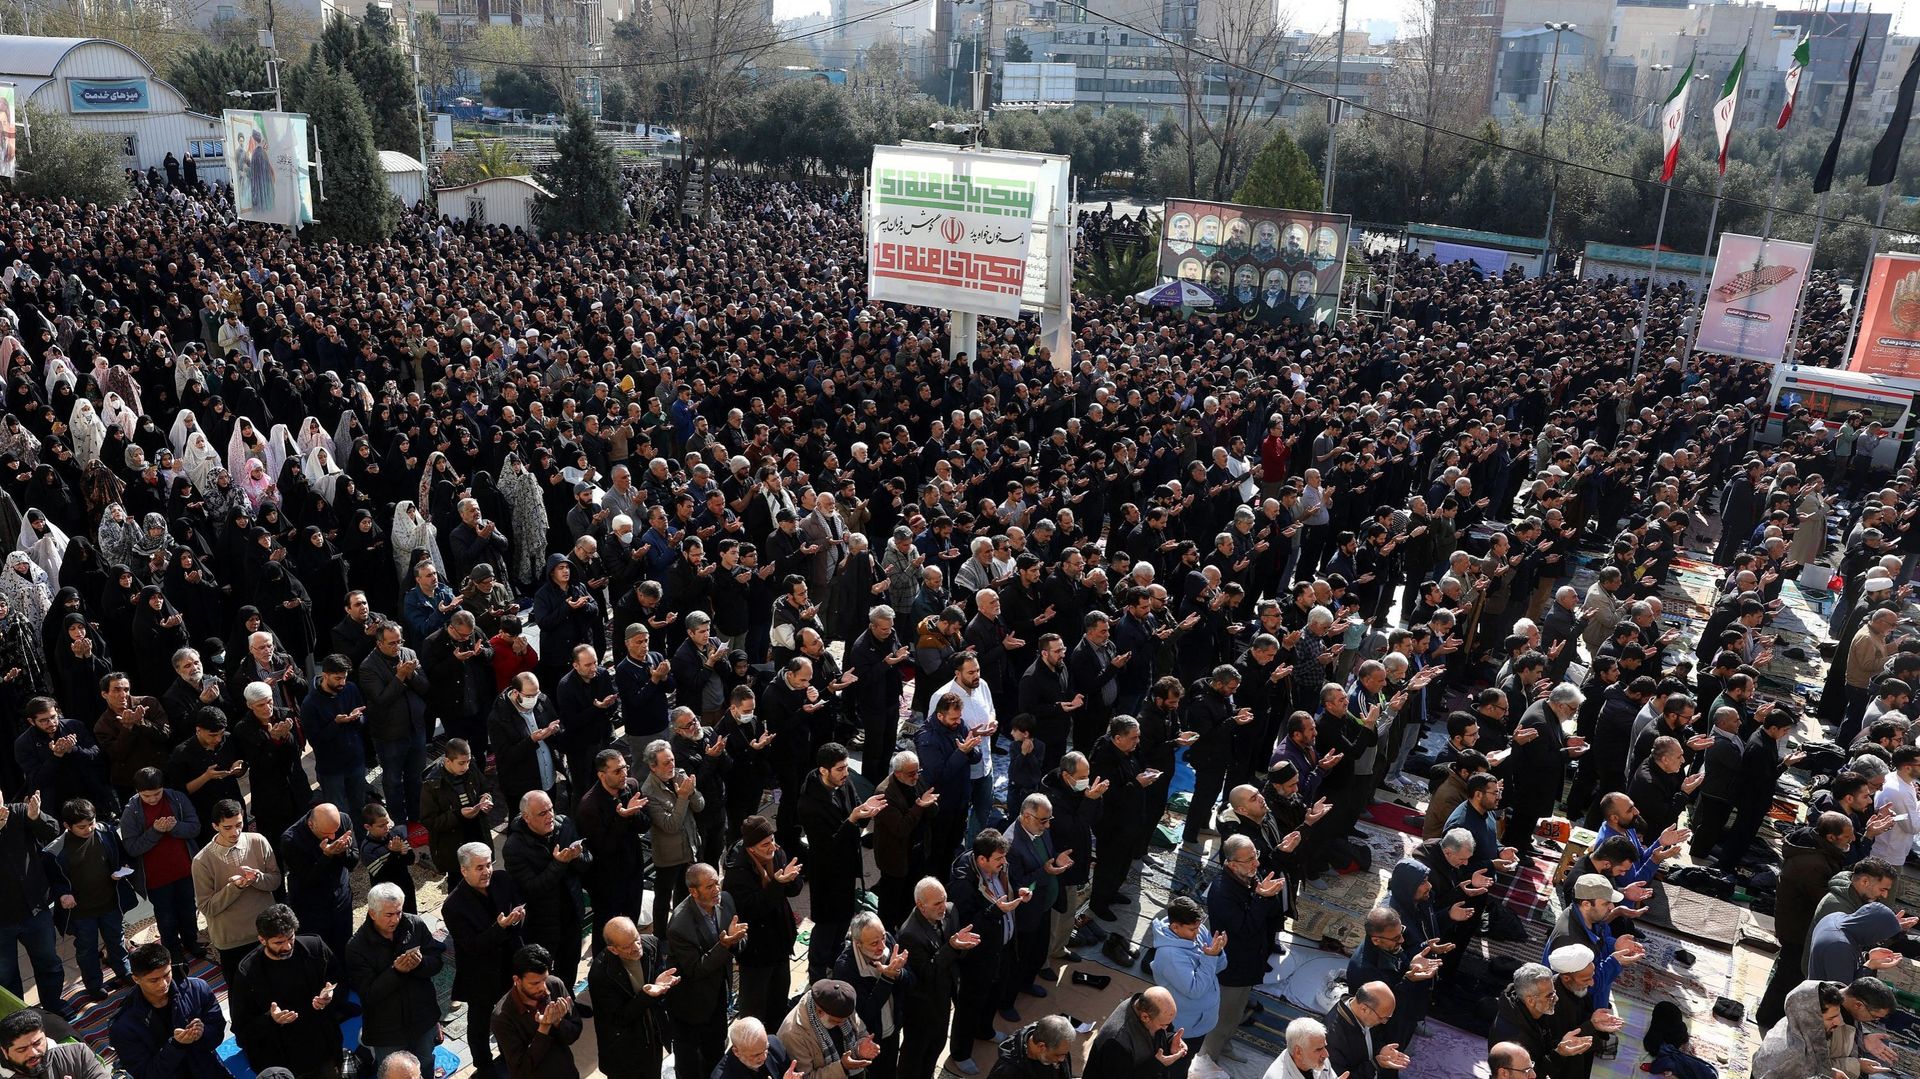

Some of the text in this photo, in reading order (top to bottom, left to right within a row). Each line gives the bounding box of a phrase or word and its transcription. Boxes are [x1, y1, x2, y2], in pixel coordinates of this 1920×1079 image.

[84, 90, 139, 101] میزهای خدمت
[876, 216, 890, 233] پسر
[886, 214, 904, 232] فرمان
[903, 210, 942, 236] گوش
